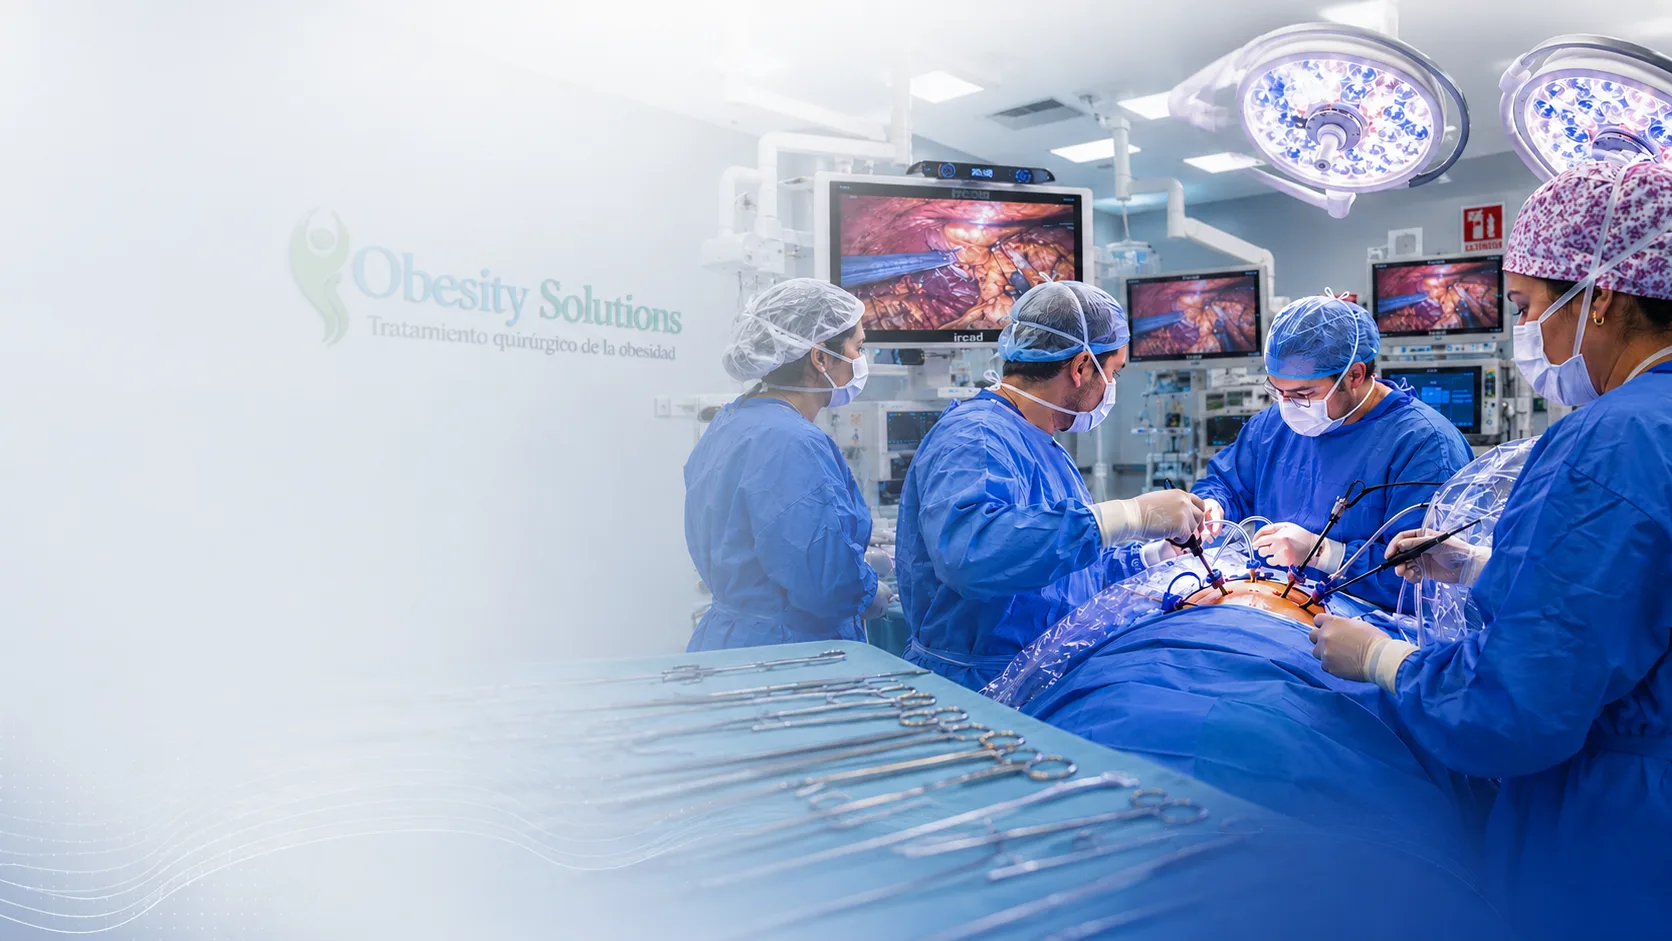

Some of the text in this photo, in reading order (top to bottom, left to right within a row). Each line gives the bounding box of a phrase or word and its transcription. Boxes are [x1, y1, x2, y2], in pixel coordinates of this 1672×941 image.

[352, 245, 683, 335] Obesity Solutions
[366, 314, 677, 361] Tratamiento quirúrgico de la obesidad
[953, 331, 984, 342] ircad
